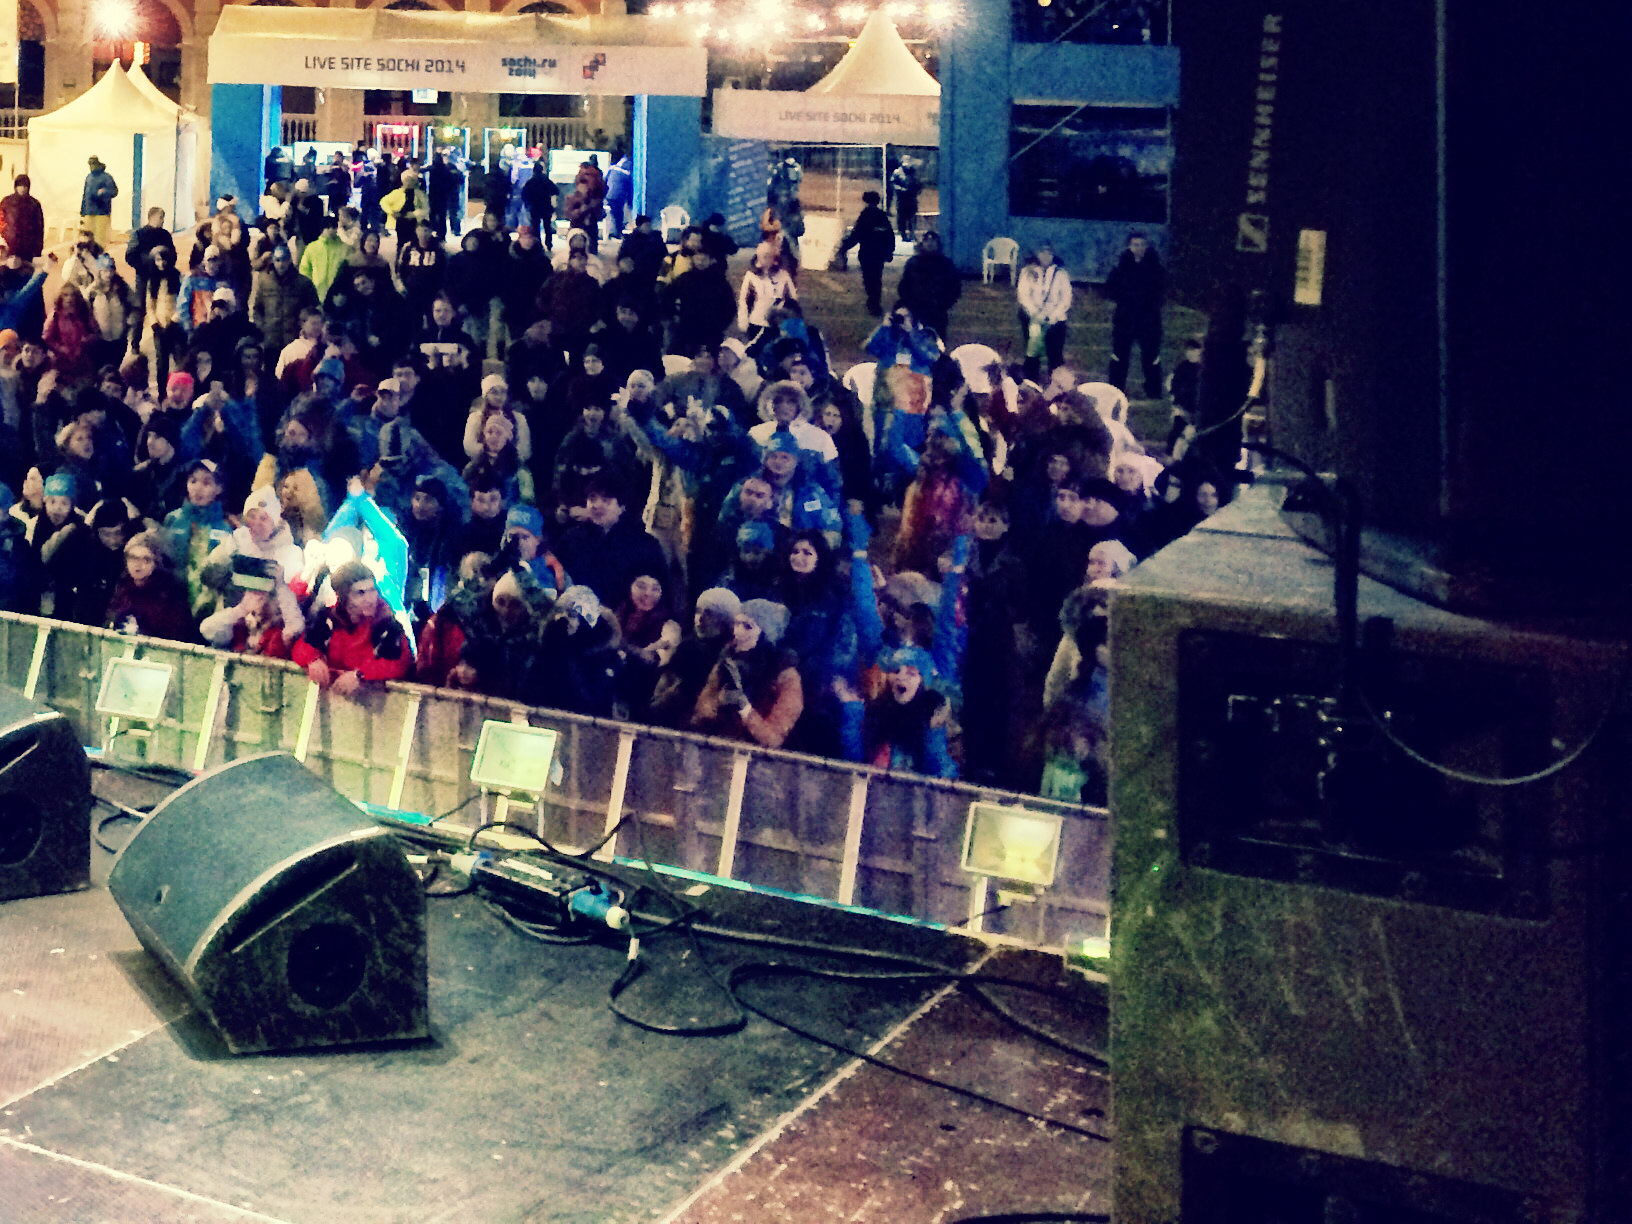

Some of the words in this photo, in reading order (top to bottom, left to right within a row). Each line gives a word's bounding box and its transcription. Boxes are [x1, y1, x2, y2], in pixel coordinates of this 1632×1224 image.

[305, 55, 336, 71] LIVE
[340, 56, 373, 72] SITE
[377, 57, 420, 73] SOCHI
[425, 58, 466, 74] 2014
[778, 111, 801, 122] LIVE
[805, 111, 830, 122] SITE
[869, 112, 901, 124] 2014
[1246, 13, 1283, 205] SENNHEISER
